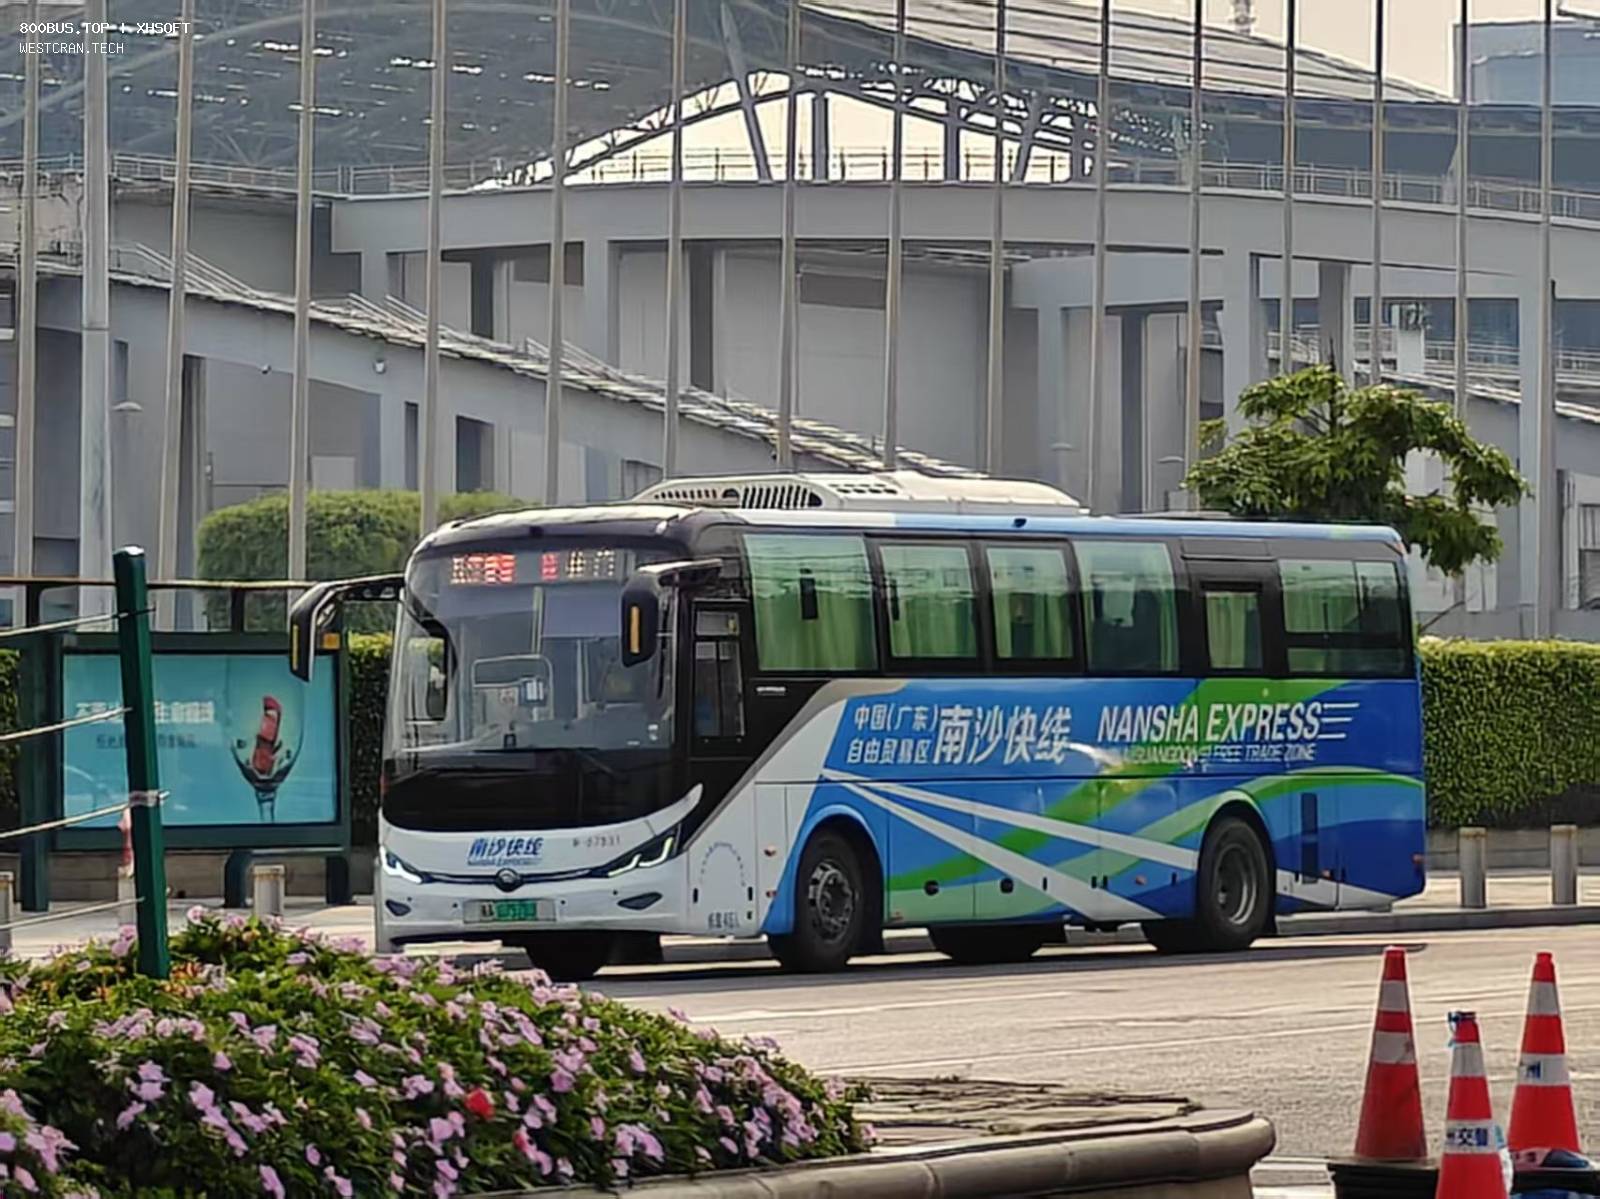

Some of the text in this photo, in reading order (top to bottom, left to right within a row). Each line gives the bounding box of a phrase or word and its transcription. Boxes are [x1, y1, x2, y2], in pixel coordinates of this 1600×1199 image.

[933, 704, 1072, 765] 南沙快线
[1097, 701, 1322, 743] NANSHA EXPRESS
